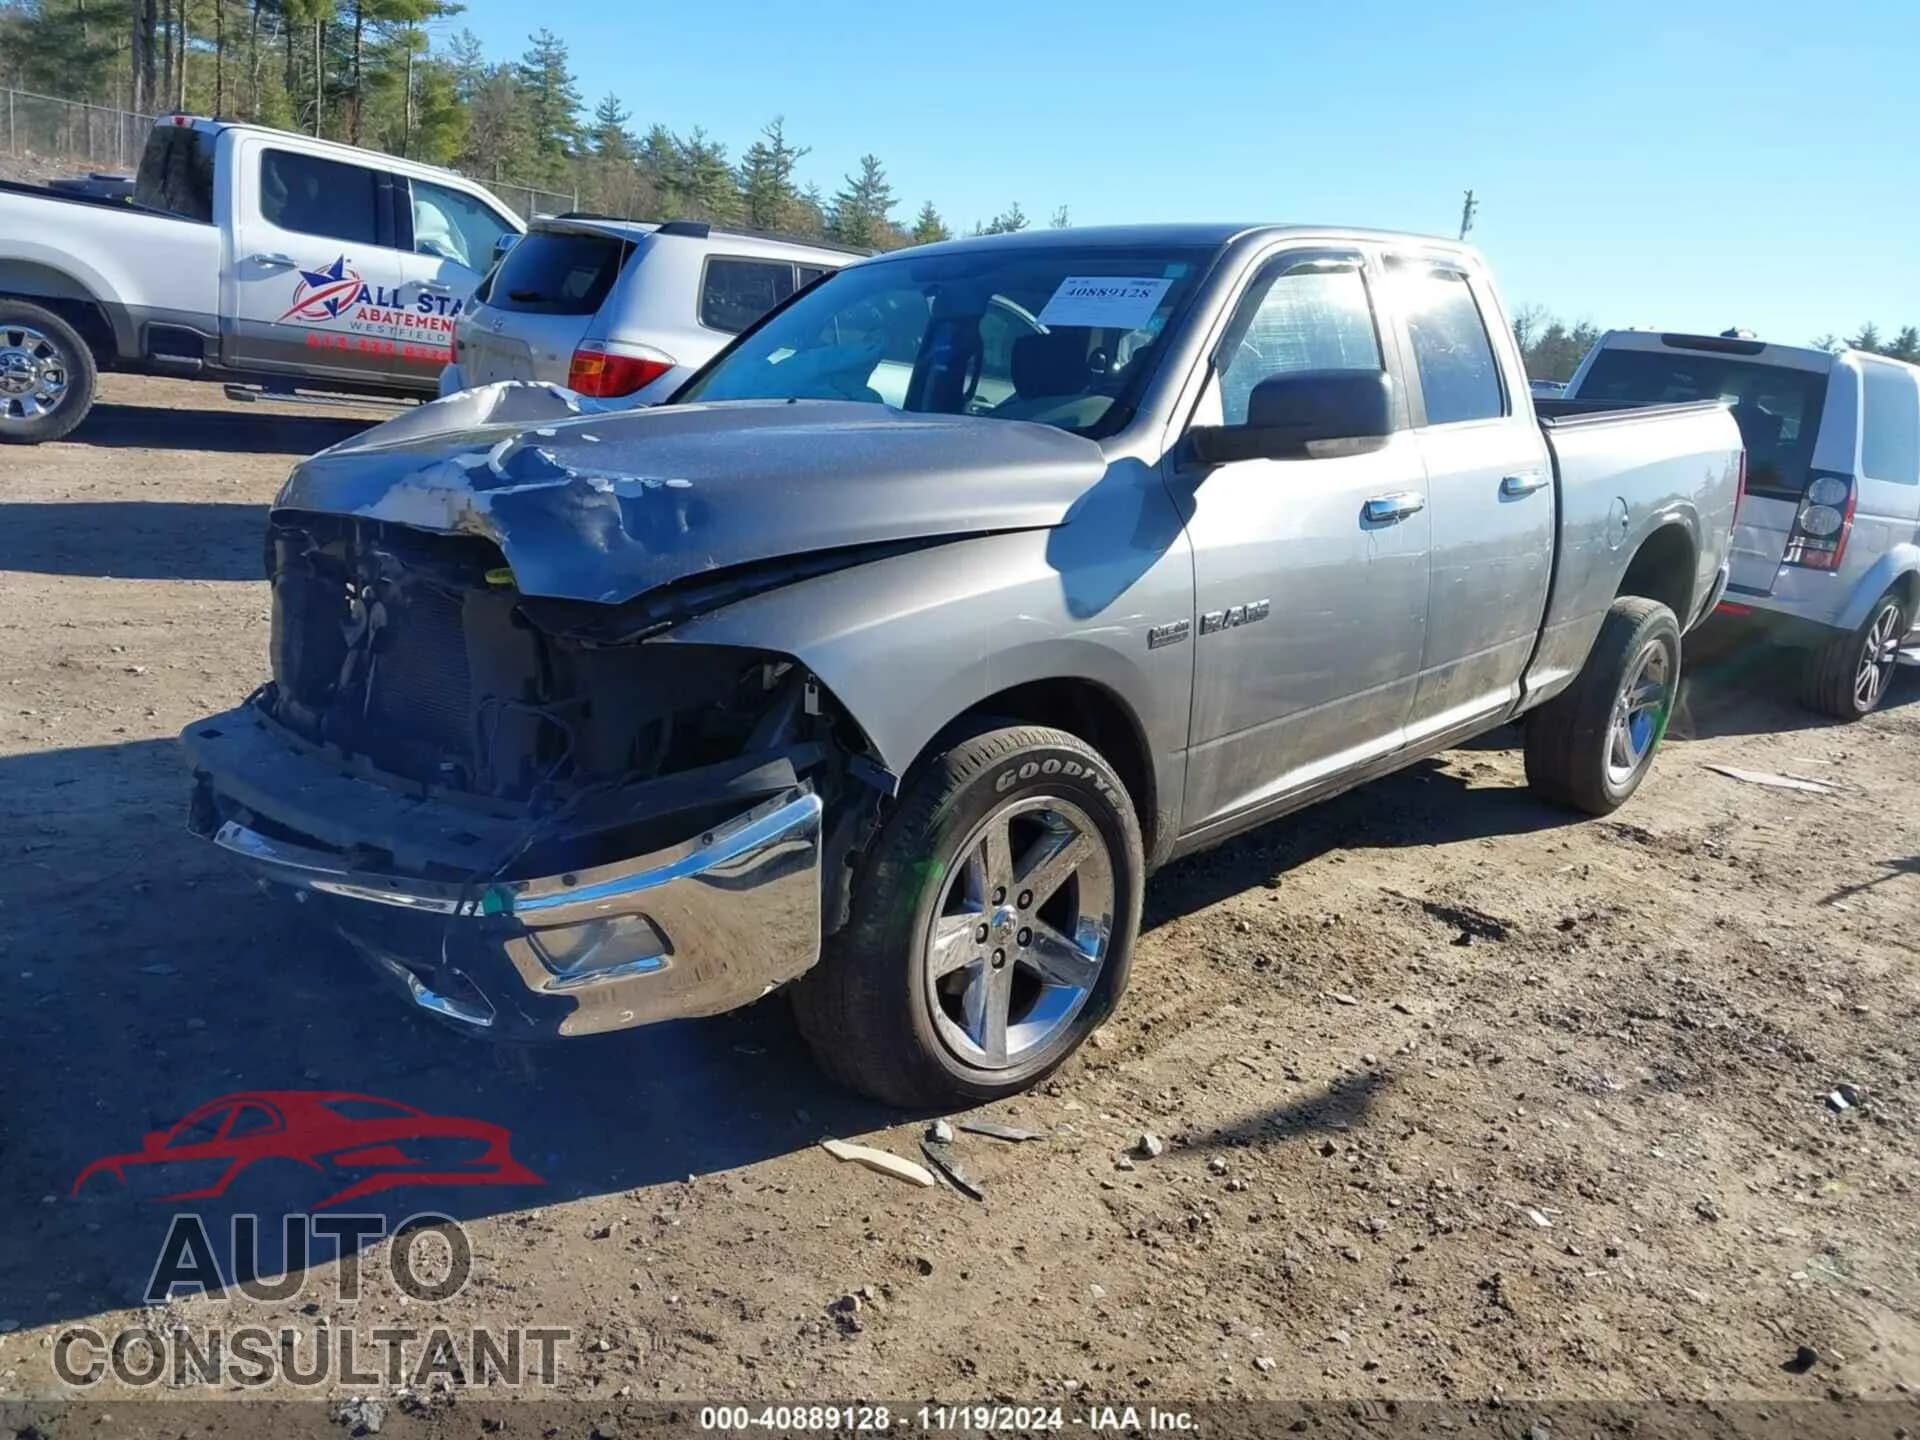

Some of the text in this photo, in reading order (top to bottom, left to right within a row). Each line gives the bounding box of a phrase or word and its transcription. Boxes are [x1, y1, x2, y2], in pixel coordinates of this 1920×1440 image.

[353, 285, 463, 317] ALL STA
[1066, 287, 1152, 298] 40889128
[350, 321, 446, 342] WESTFIELD
[356, 307, 453, 333] ABATEMEN
[996, 758, 1120, 809] GOODYE
